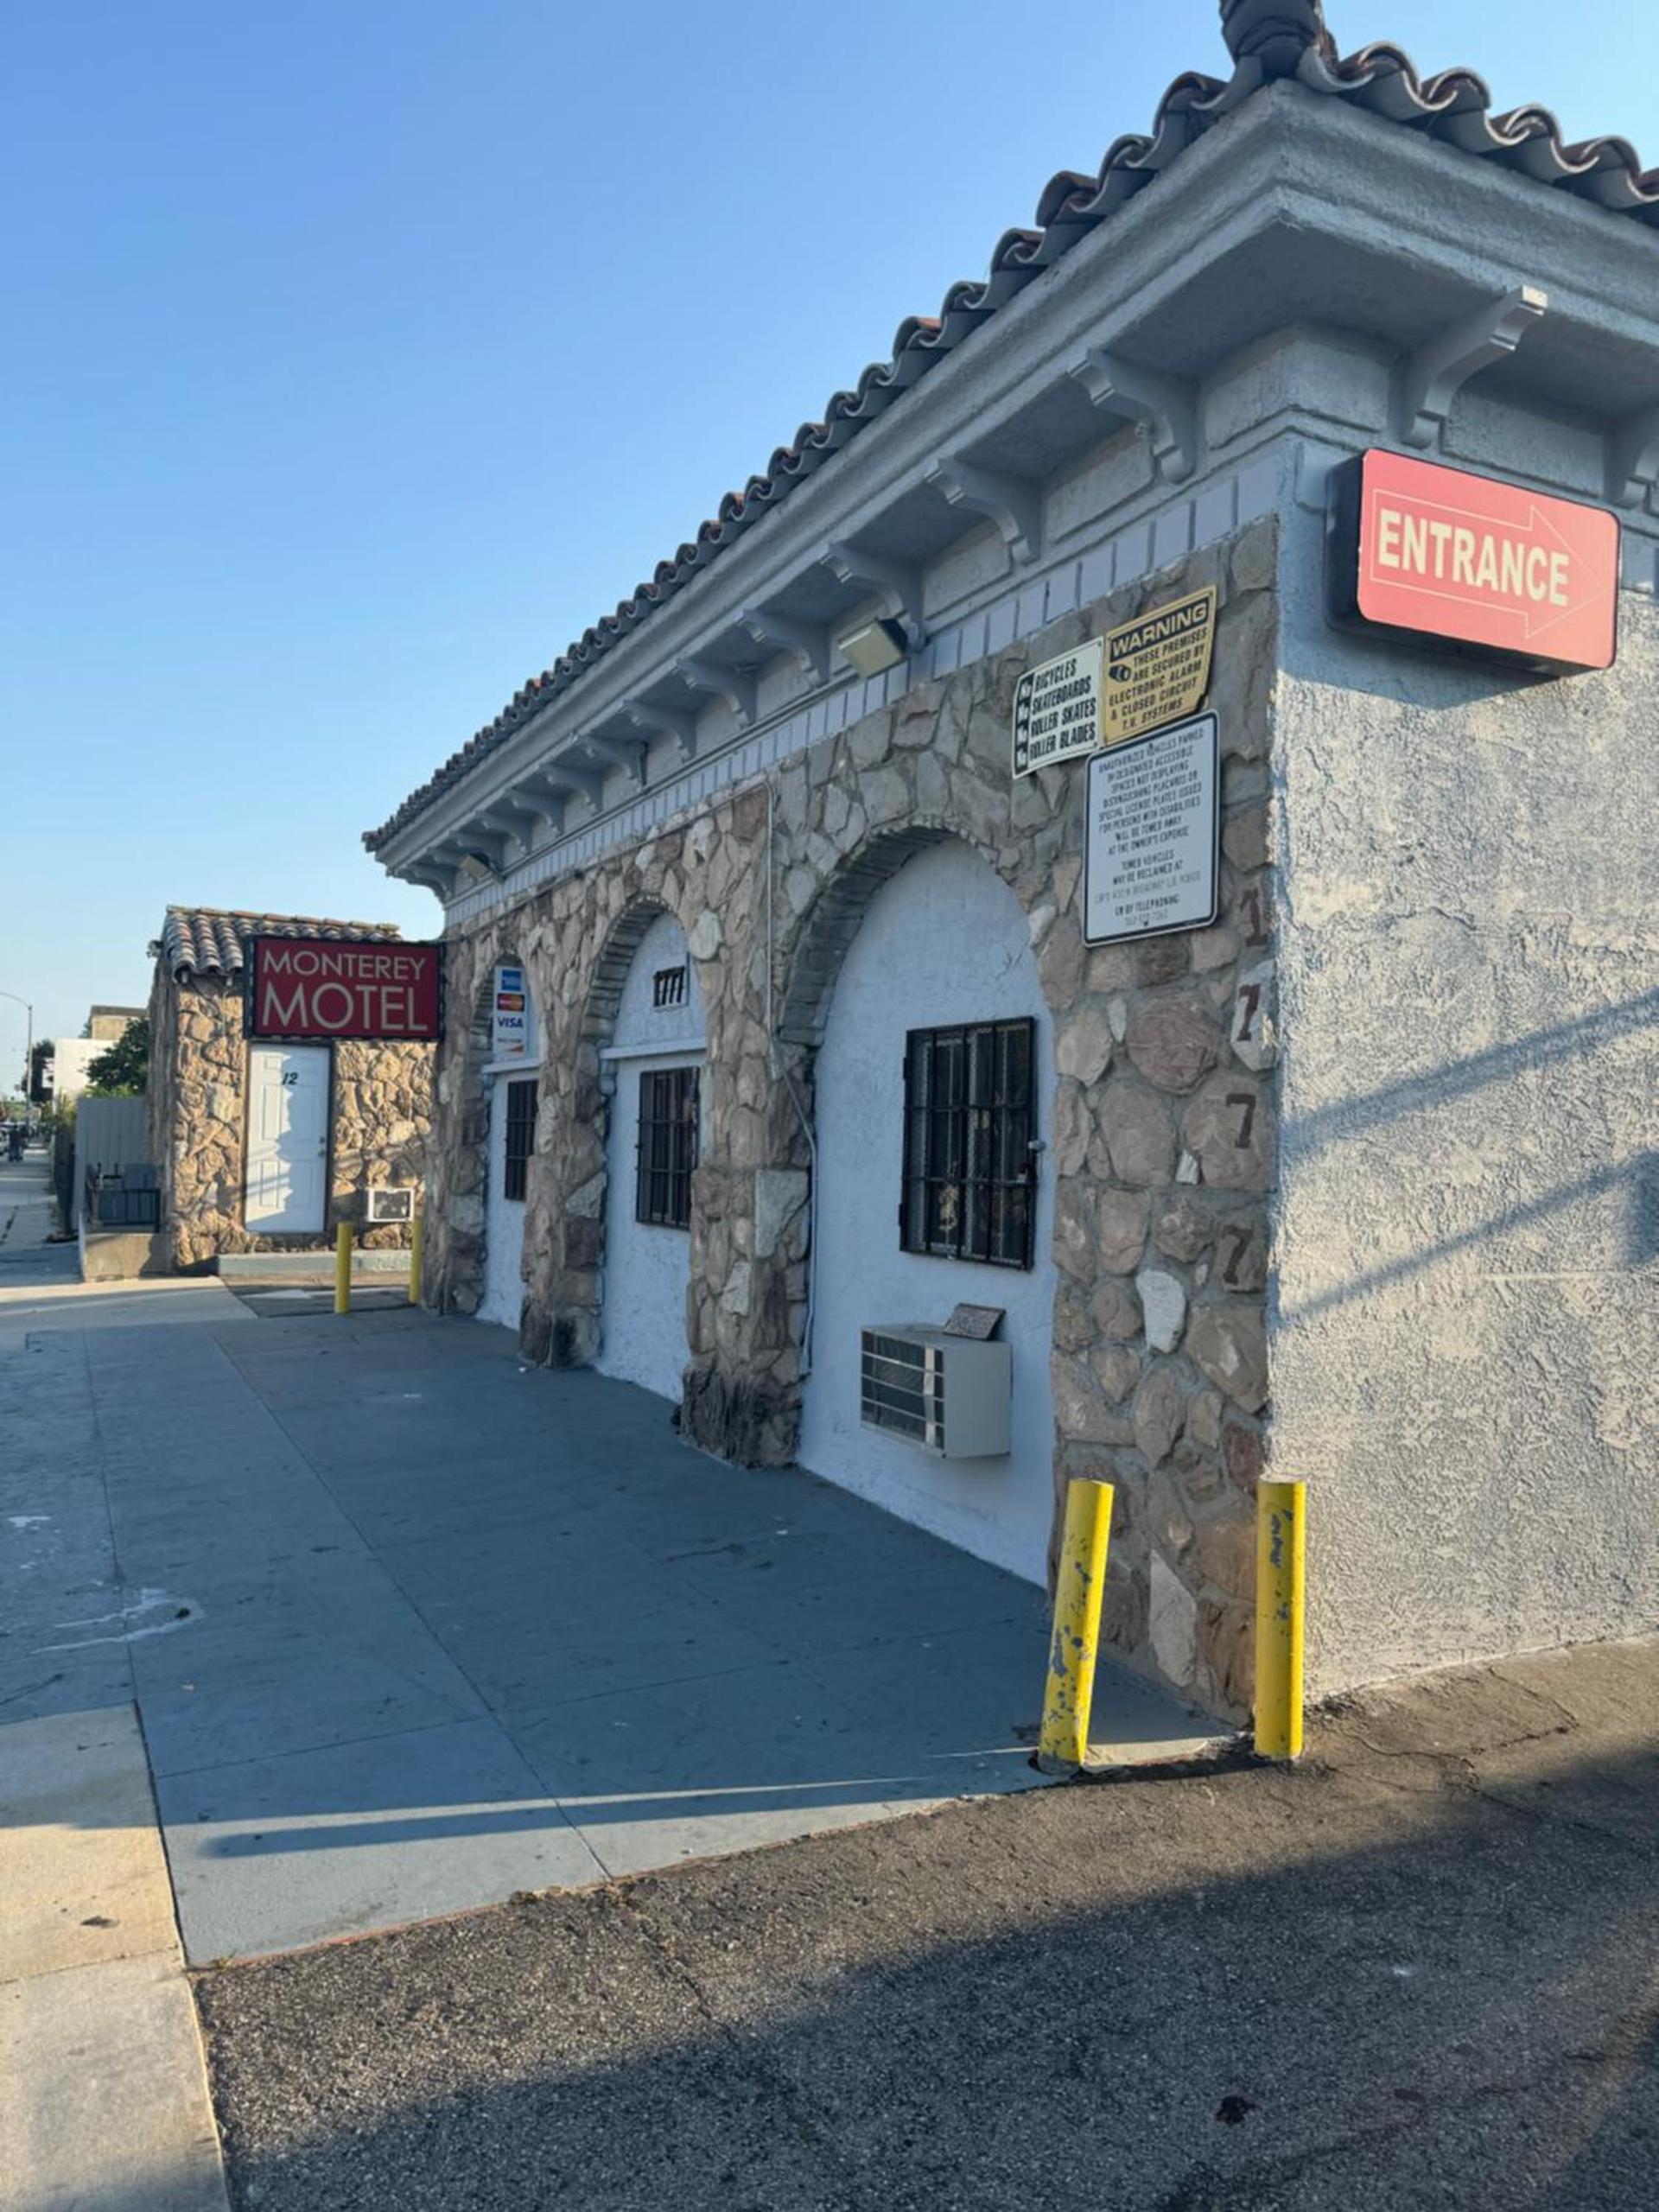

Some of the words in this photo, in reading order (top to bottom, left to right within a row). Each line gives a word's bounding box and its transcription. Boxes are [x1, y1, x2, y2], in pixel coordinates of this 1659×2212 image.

[1378, 507, 1569, 606] ENTRANCE
[1112, 602, 1207, 657] WARNING
[1133, 647, 1160, 667] THESE
[1162, 627, 1206, 655] PREMISES
[1035, 658, 1077, 691] BICYCLES
[1133, 666, 1148, 683] ARE
[1152, 649, 1191, 674] SECURED
[1193, 642, 1205, 658] BY
[1032, 674, 1091, 715] SKATEBOARDS
[1109, 675, 1165, 707] ELECTRONIC
[1169, 659, 1201, 681] ALARM
[1122, 693, 1155, 716] CLOSED
[1159, 677, 1196, 701] CIRCUIT
[1031, 712, 1058, 735] ROLLER
[1062, 696, 1096, 725] SKATES
[1141, 696, 1182, 722] SYSTEMS
[1029, 735, 1055, 759] ROLLER
[1059, 721, 1095, 748] BLADES
[264, 950, 426, 981] MONTEREY
[261, 982, 429, 1033] MOTEL
[498, 1016, 524, 1028] VISA
[282, 1071, 298, 1085] 12
